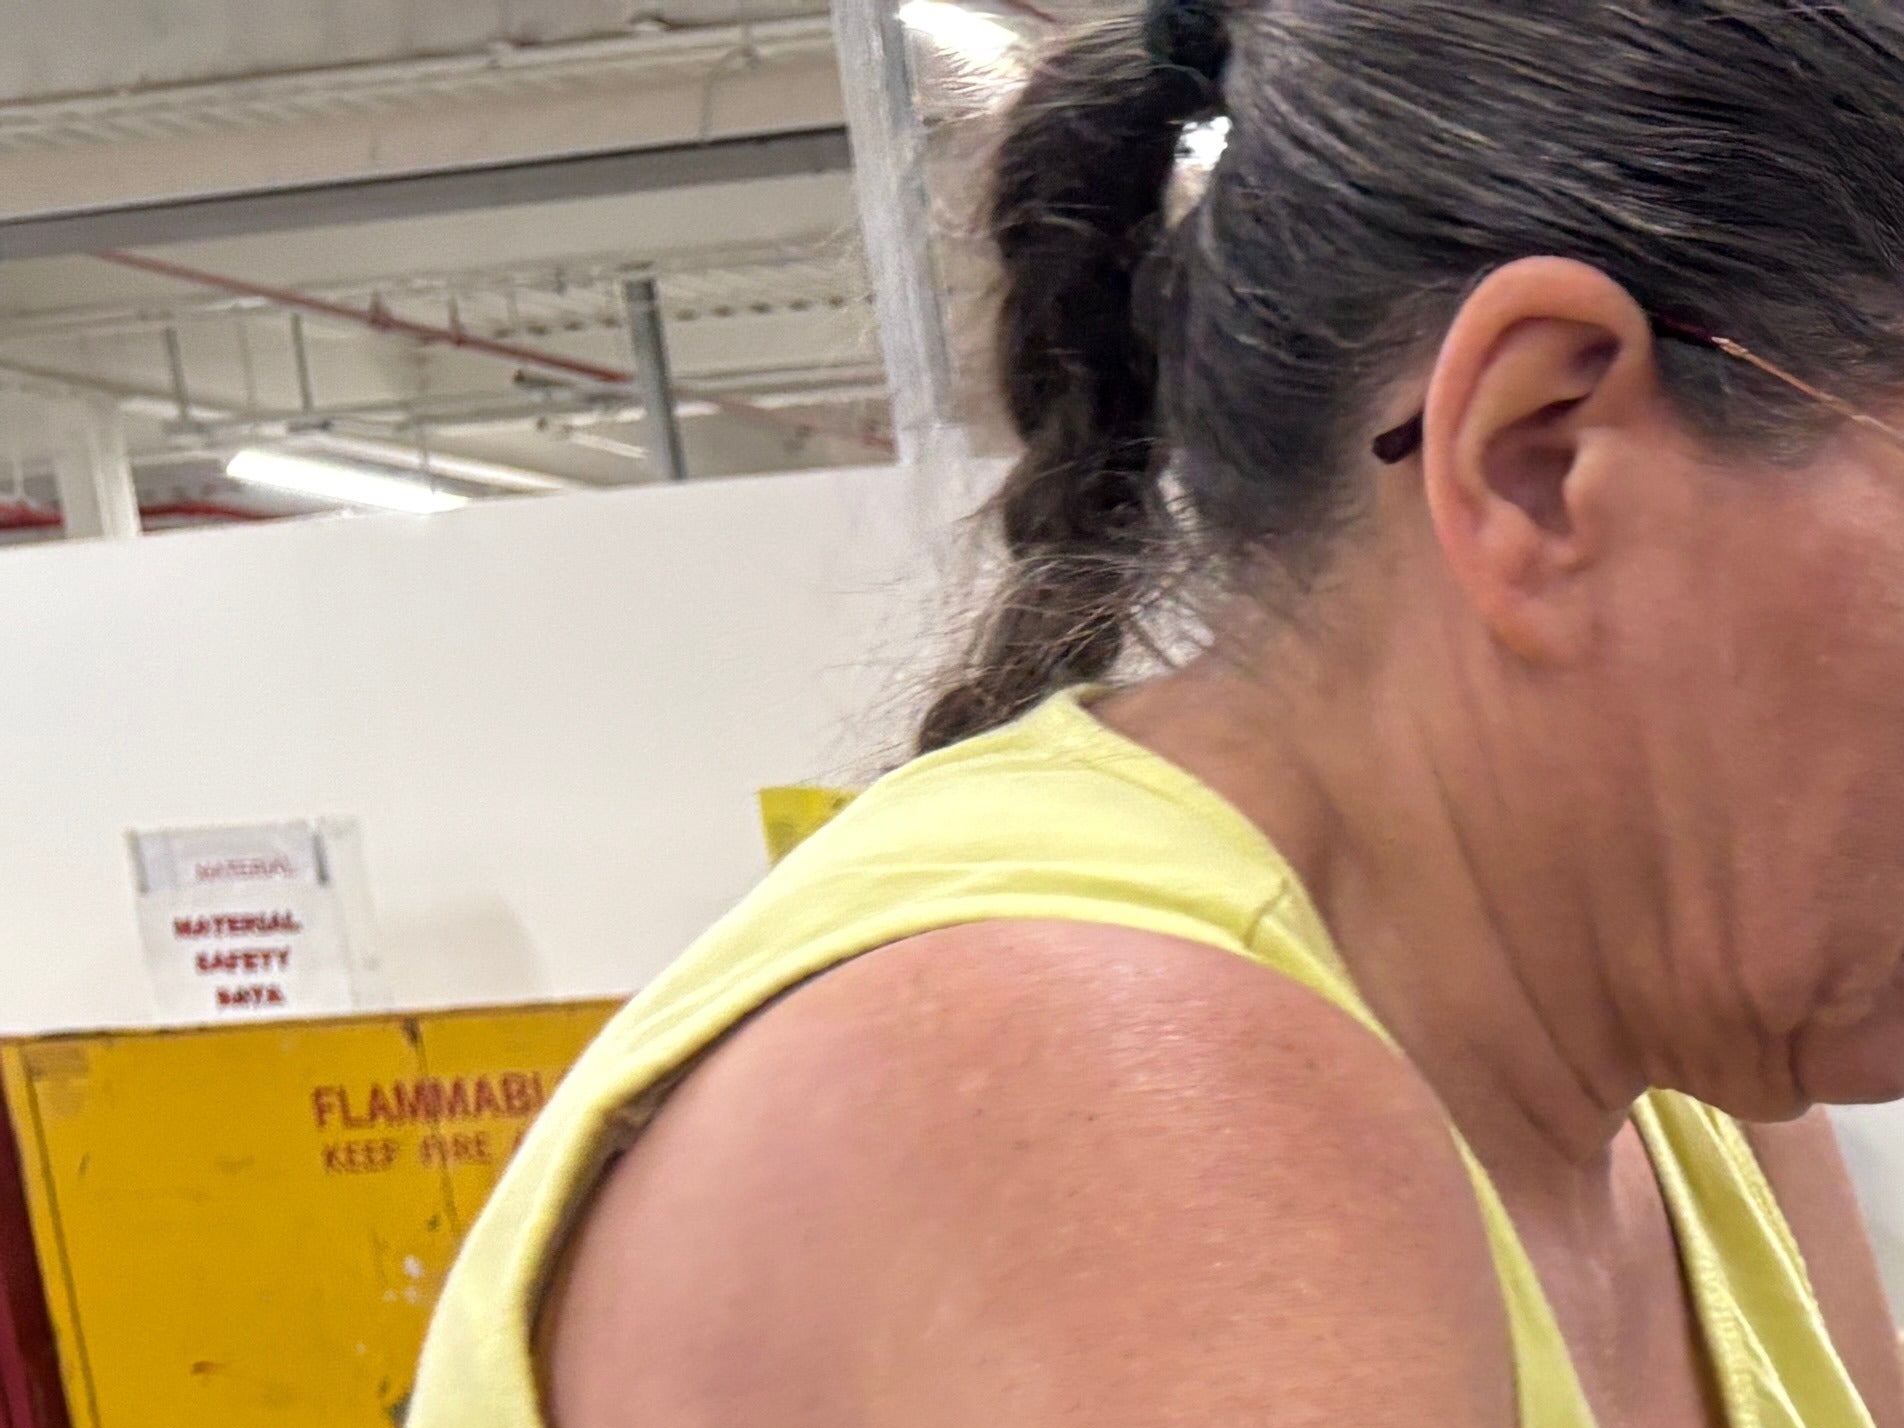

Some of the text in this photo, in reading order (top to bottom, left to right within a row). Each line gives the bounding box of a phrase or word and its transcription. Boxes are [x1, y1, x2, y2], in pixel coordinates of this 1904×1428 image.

[173, 909, 303, 938] MATERIAL
[195, 946, 292, 974] SAFETY
[215, 984, 285, 1008] DATA
[312, 1070, 547, 1129] FLAMMABL
